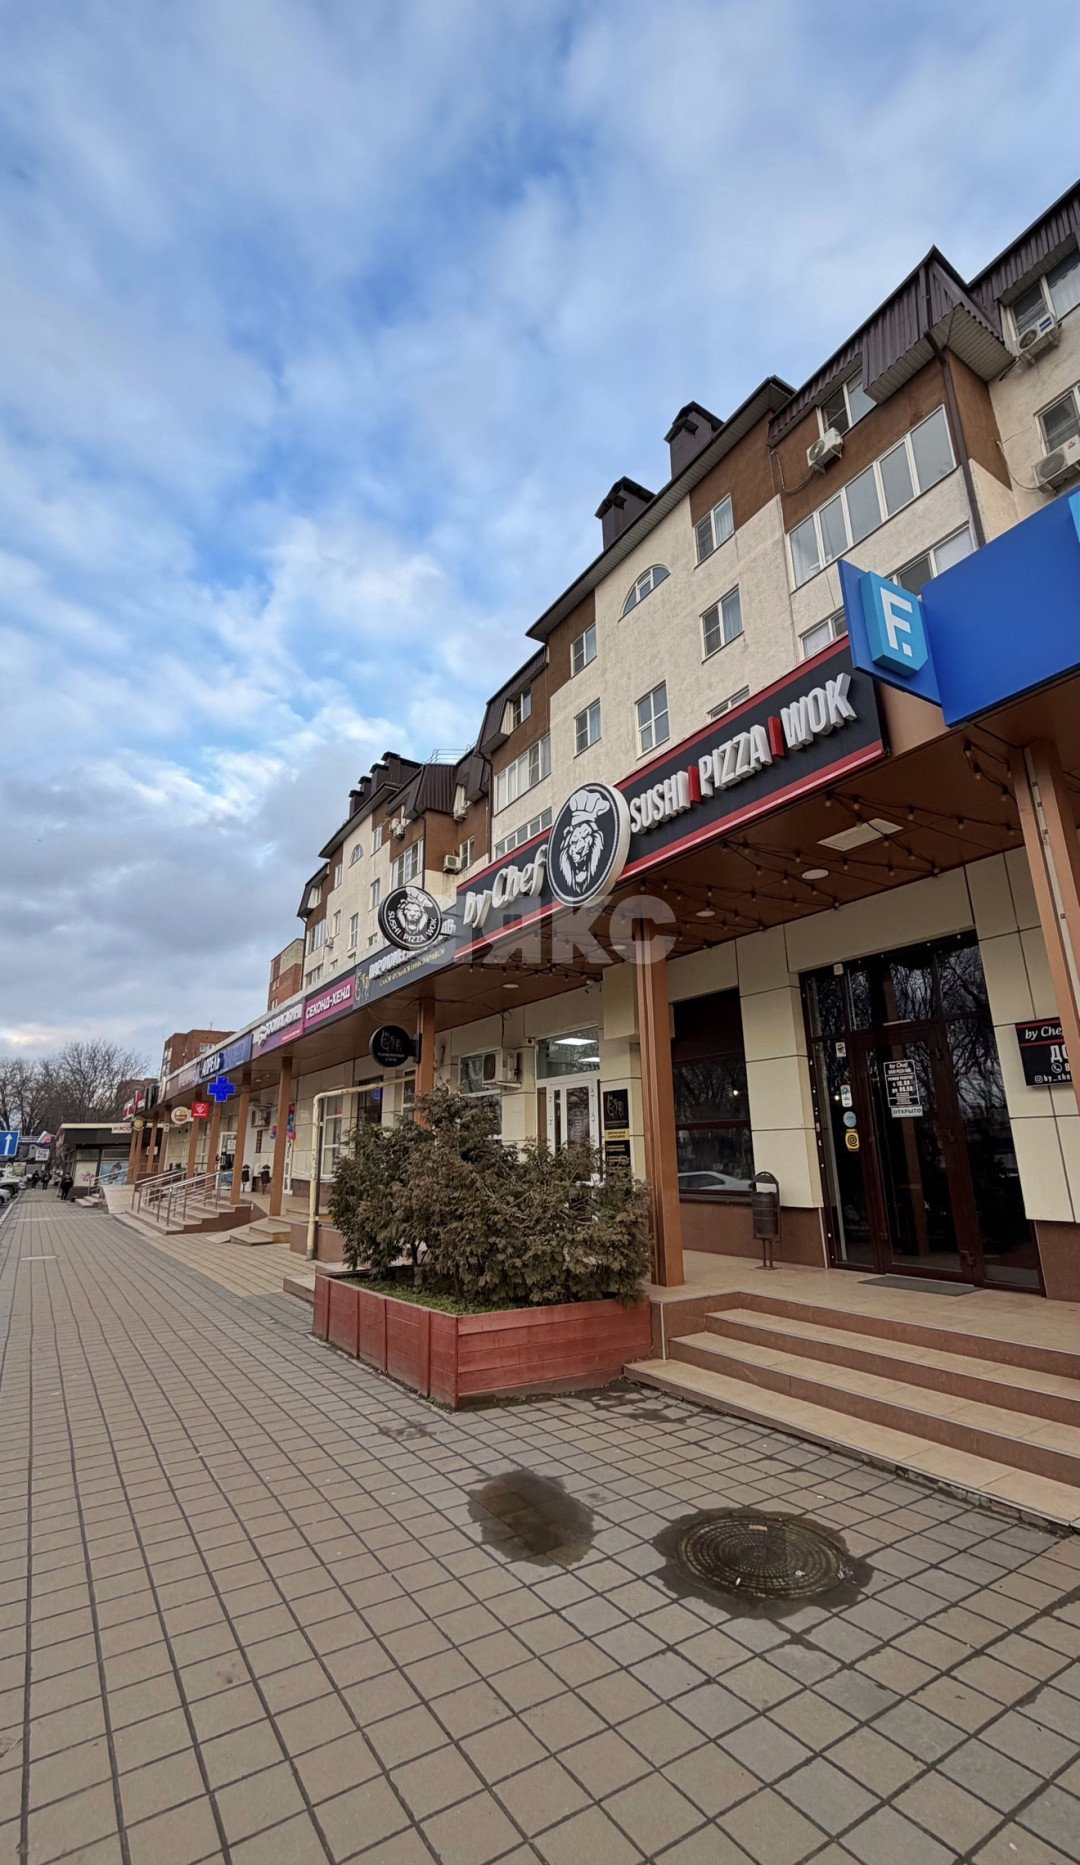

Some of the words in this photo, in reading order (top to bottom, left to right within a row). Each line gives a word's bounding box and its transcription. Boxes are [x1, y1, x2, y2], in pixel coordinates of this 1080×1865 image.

[630, 770, 692, 835] SUSHI
[698, 724, 773, 798] PIZZA
[780, 672, 858, 751] WOK
[463, 891, 492, 930] by
[492, 844, 548, 909] Chef
[388, 910, 402, 935] SUSHI
[402, 933, 426, 943] PIZZA
[425, 917, 437, 936] WOK
[305, 985, 351, 1019] СЕКОНД-ХЕНД
[1025, 1029, 1038, 1040] by
[1041, 1026, 1062, 1037] Che
[1050, 1044, 1068, 1063] ДО
[1043, 1073, 1071, 1083] by_che
[1064, 1062, 1071, 1072] 8
